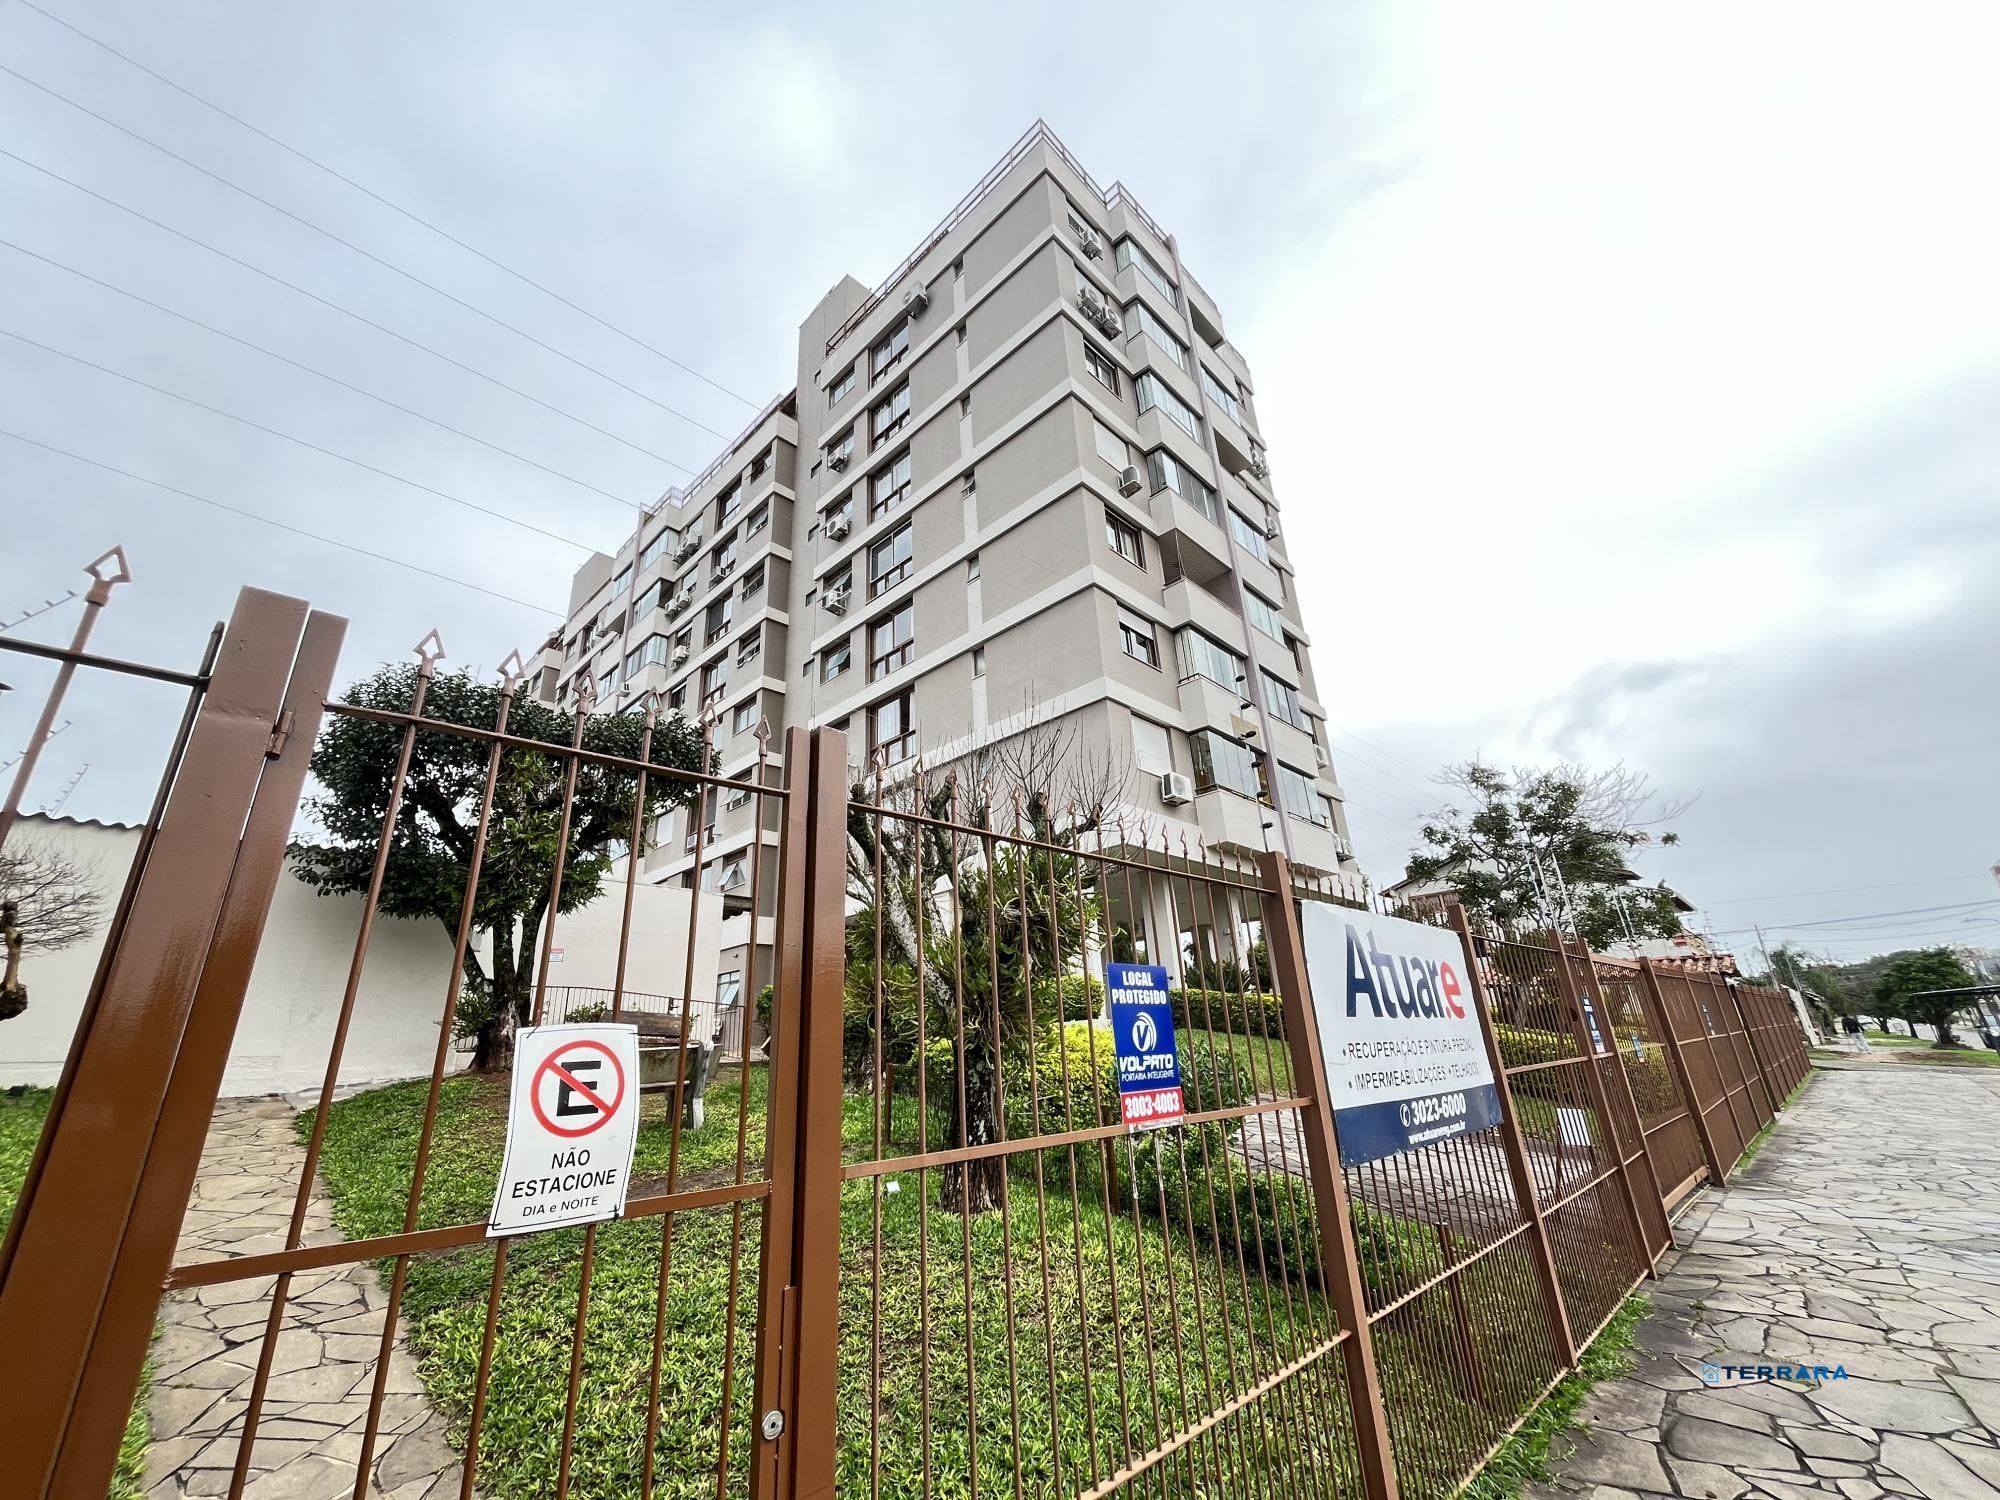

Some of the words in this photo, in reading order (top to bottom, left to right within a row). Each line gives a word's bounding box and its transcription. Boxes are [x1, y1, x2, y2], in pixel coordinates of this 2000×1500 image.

[1121, 970, 1154, 986] LOCAL
[1111, 988, 1167, 1005] PROTEGIDO
[1347, 1037, 1417, 1060] RECUPERAÇÃO
[1419, 1040, 1424, 1055] E
[1425, 1039, 1453, 1054] PINTURA
[1119, 1053, 1174, 1073] VOLPATO
[1121, 1072, 1147, 1082] PORTARIA
[1147, 1069, 1175, 1080] INTELIGENTE
[1354, 1063, 1447, 1091] IMPERMEABILIZAÇÕES
[556, 1060, 602, 1117] E
[1124, 1091, 1180, 1119] 3003-4003
[1411, 1092, 1467, 1126] 3023-6000
[551, 1147, 591, 1170] NÃO
[511, 1169, 617, 1199] ESTACIONE
[522, 1205, 546, 1217] DIA
[549, 1204, 557, 1213] e
[560, 1196, 600, 1212] NOITE
